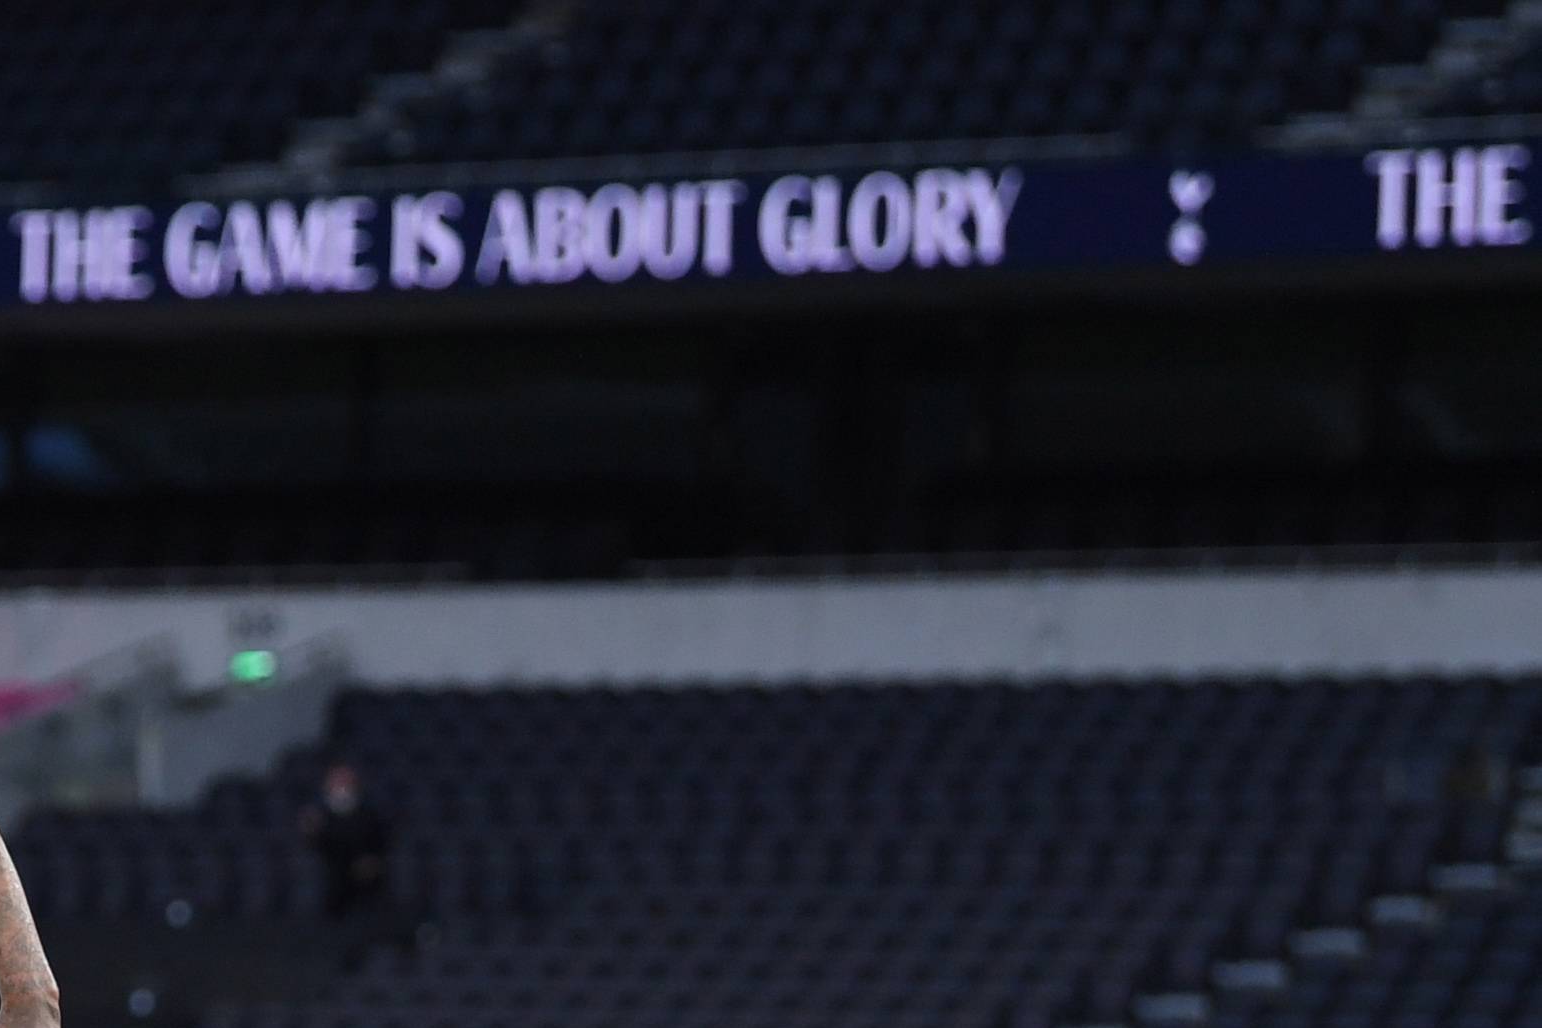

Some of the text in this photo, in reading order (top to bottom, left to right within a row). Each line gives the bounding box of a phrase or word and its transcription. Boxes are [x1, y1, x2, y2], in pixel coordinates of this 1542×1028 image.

[10, 167, 1022, 303] THE GAME IS ABOUT GLORY
[1365, 145, 1532, 250] THE
